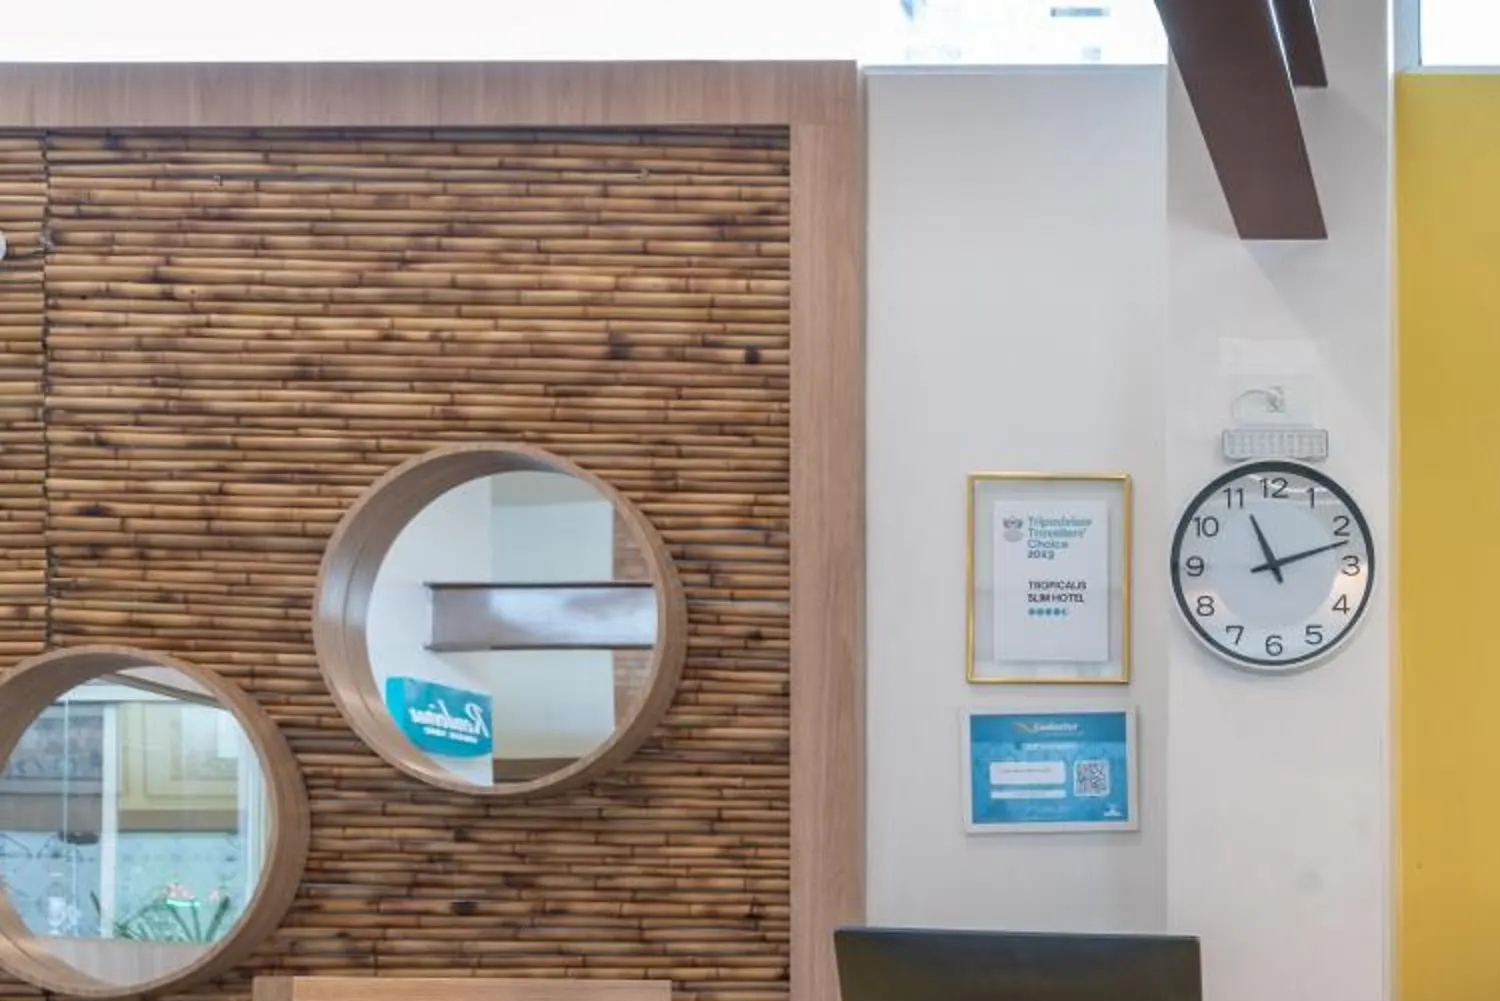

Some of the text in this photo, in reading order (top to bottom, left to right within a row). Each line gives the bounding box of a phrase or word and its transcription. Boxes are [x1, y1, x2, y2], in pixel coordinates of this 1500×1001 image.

[1223, 488, 1244, 509] 11
[1260, 478, 1289, 499] 12
[1308, 488, 1316, 509] 1
[1193, 516, 1219, 538] 10
[1333, 515, 1350, 537] 2
[1027, 539, 1069, 549] Choice
[1186, 556, 1205, 577] 9
[1341, 555, 1360, 577] 3
[1028, 581, 1087, 590] TROPICALIS
[1028, 593, 1084, 603] SLIM HOTEL
[1196, 595, 1215, 617] 8
[1332, 594, 1350, 615] 4
[1225, 625, 1244, 646] 7
[1265, 635, 1283, 657] 6
[1305, 625, 1323, 646] 5
